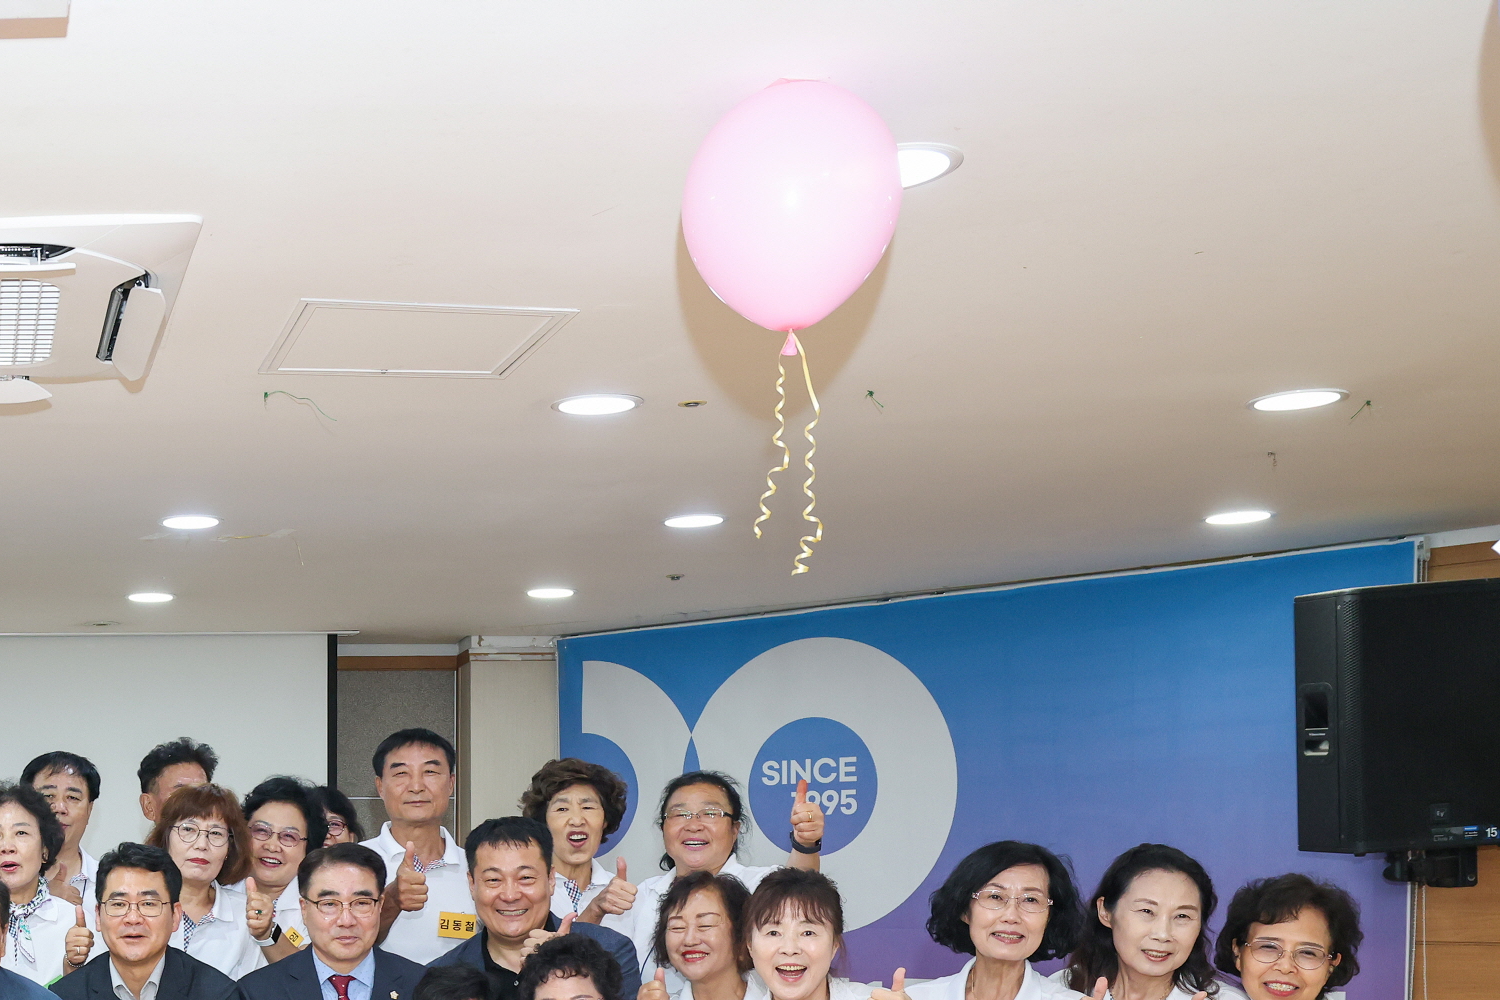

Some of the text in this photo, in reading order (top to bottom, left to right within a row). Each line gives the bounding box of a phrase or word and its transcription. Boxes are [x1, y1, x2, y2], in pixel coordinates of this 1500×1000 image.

[762, 756, 858, 786] SINCE
[791, 789, 858, 816] 995
[1485, 826, 1498, 838] 15
[439, 918, 475, 933] 김동철
